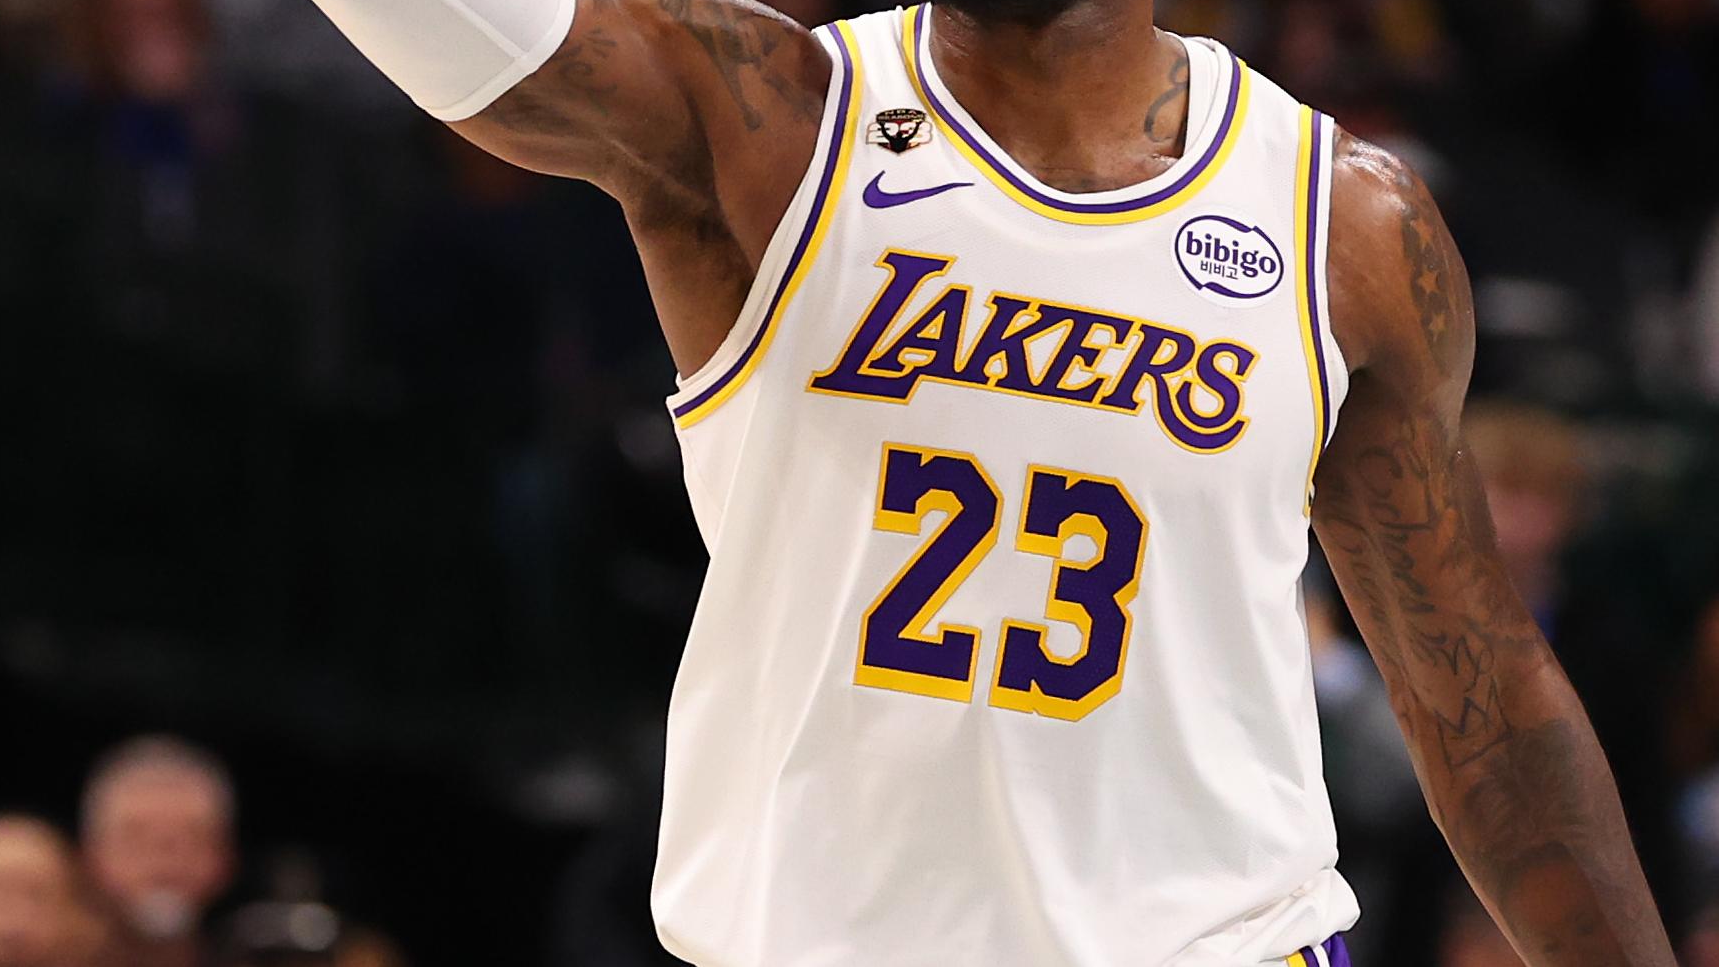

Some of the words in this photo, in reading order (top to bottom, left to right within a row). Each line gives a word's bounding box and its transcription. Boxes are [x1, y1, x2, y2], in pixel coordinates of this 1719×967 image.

[1185, 230, 1277, 278] bibigo
[1199, 259, 1240, 281] 비비고
[804, 247, 1262, 455] LAKERS
[852, 440, 1150, 722] 23
